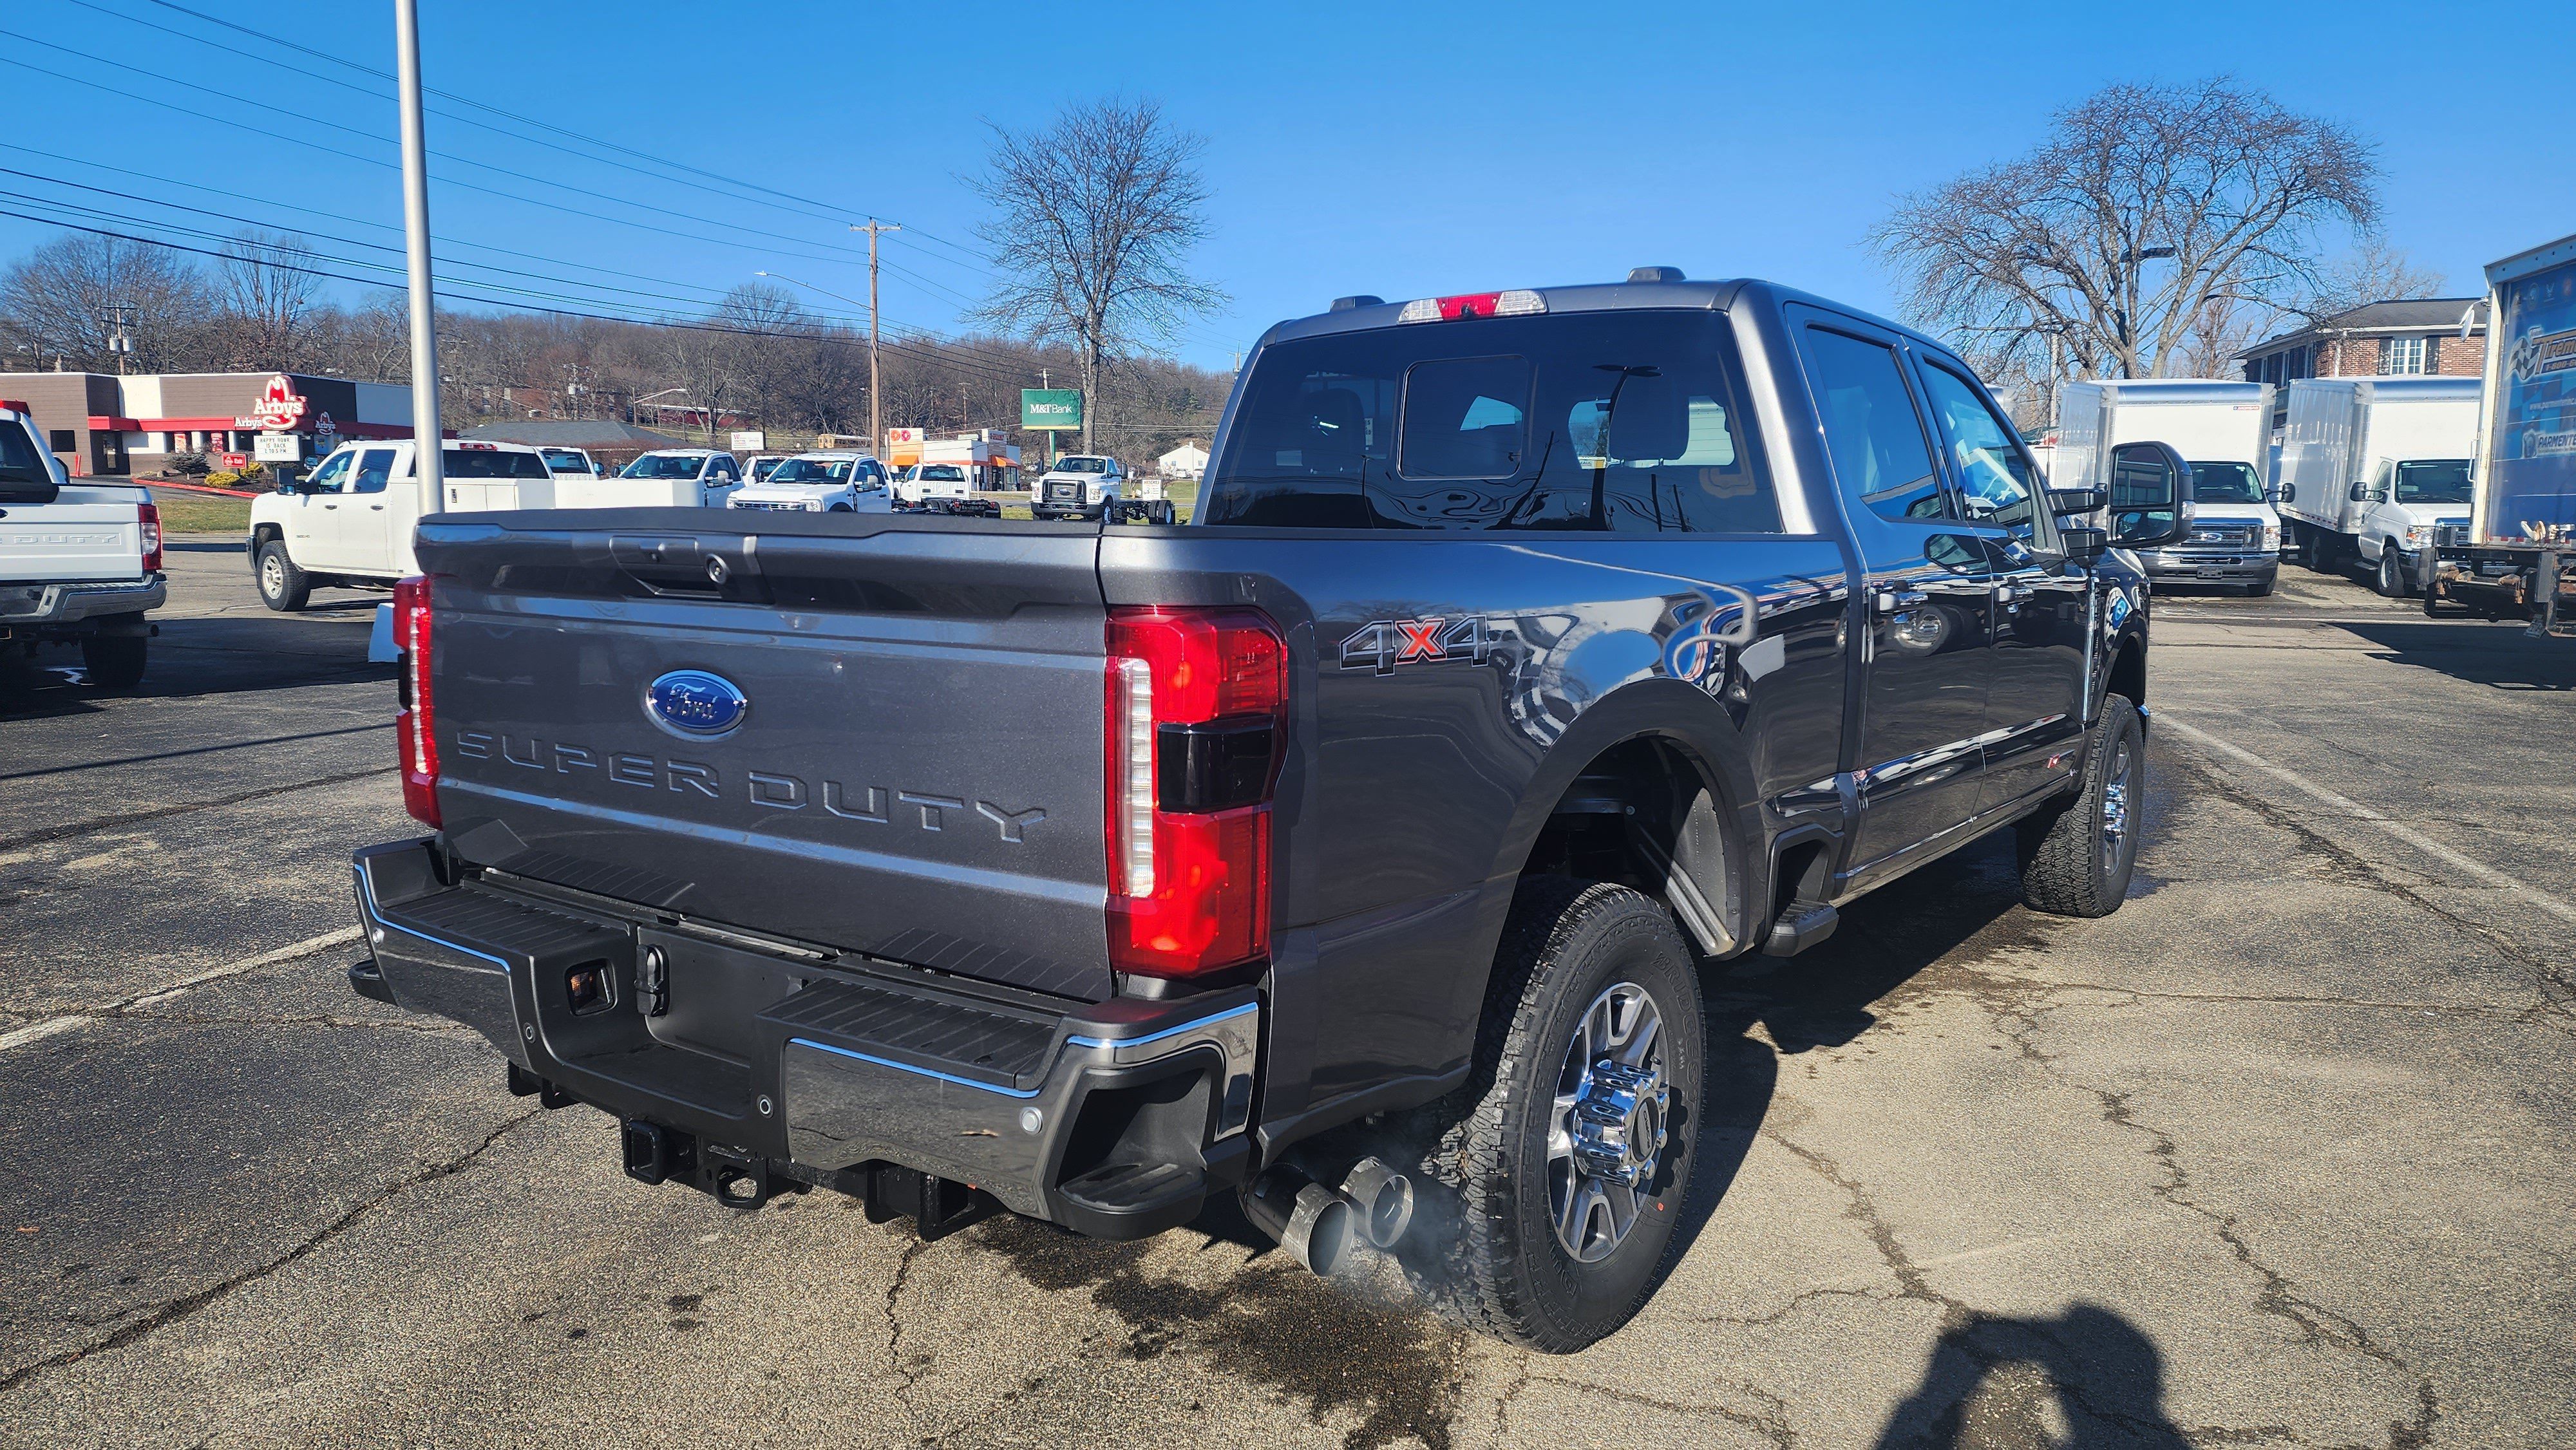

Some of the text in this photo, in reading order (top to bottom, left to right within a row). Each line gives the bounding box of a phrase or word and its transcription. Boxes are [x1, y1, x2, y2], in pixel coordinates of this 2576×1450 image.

[2532, 329, 2576, 375] Tirem
[254, 397, 303, 419] Arby's
[1030, 404, 1073, 413] M&T Bank
[234, 417, 263, 429] Arby's
[13, 535, 117, 544] DUTY
[667, 682, 718, 719] Ford
[457, 730, 1047, 845] SUPER DUTY
